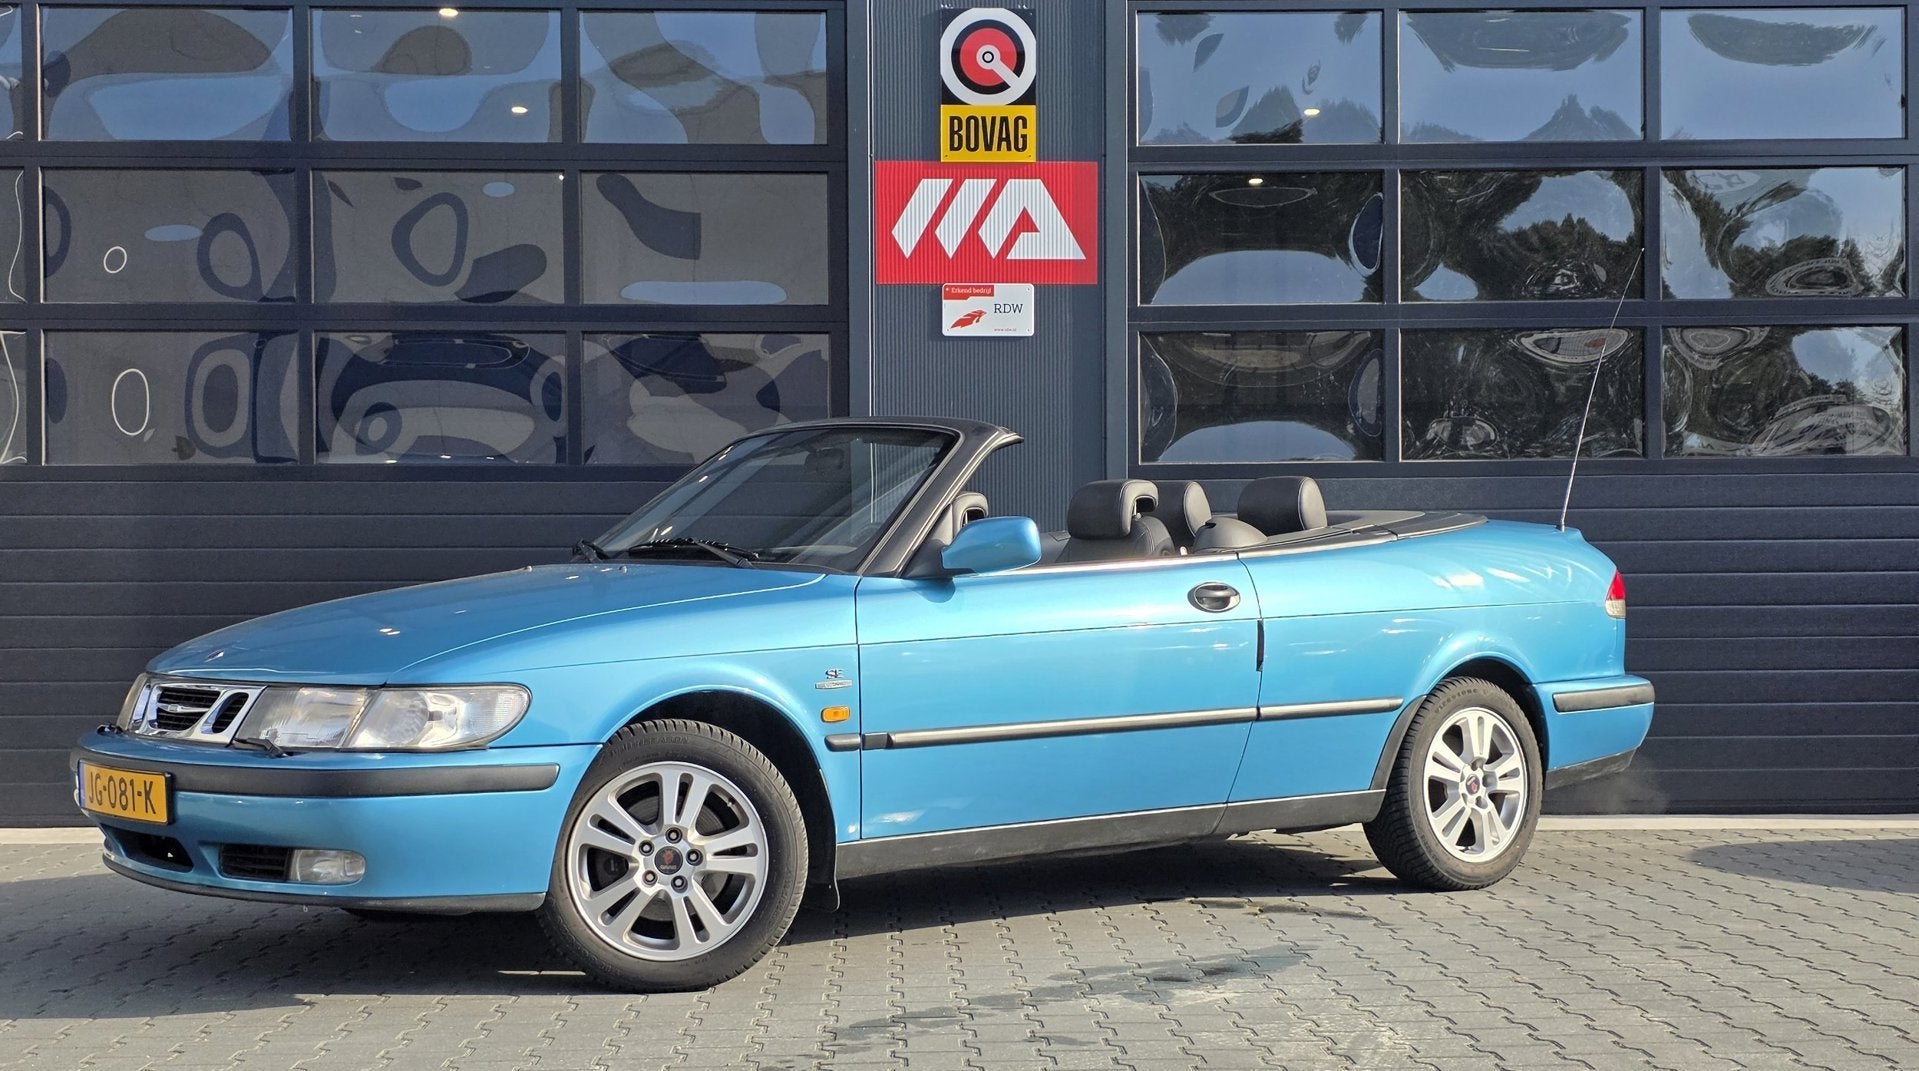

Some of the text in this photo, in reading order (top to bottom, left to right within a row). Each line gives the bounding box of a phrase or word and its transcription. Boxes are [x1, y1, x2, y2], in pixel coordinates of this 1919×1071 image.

[949, 115, 1028, 152] BOVAG
[973, 287, 992, 295] bedrijf
[993, 303, 1024, 314] RDW
[88, 771, 156, 815] JG-081-K
